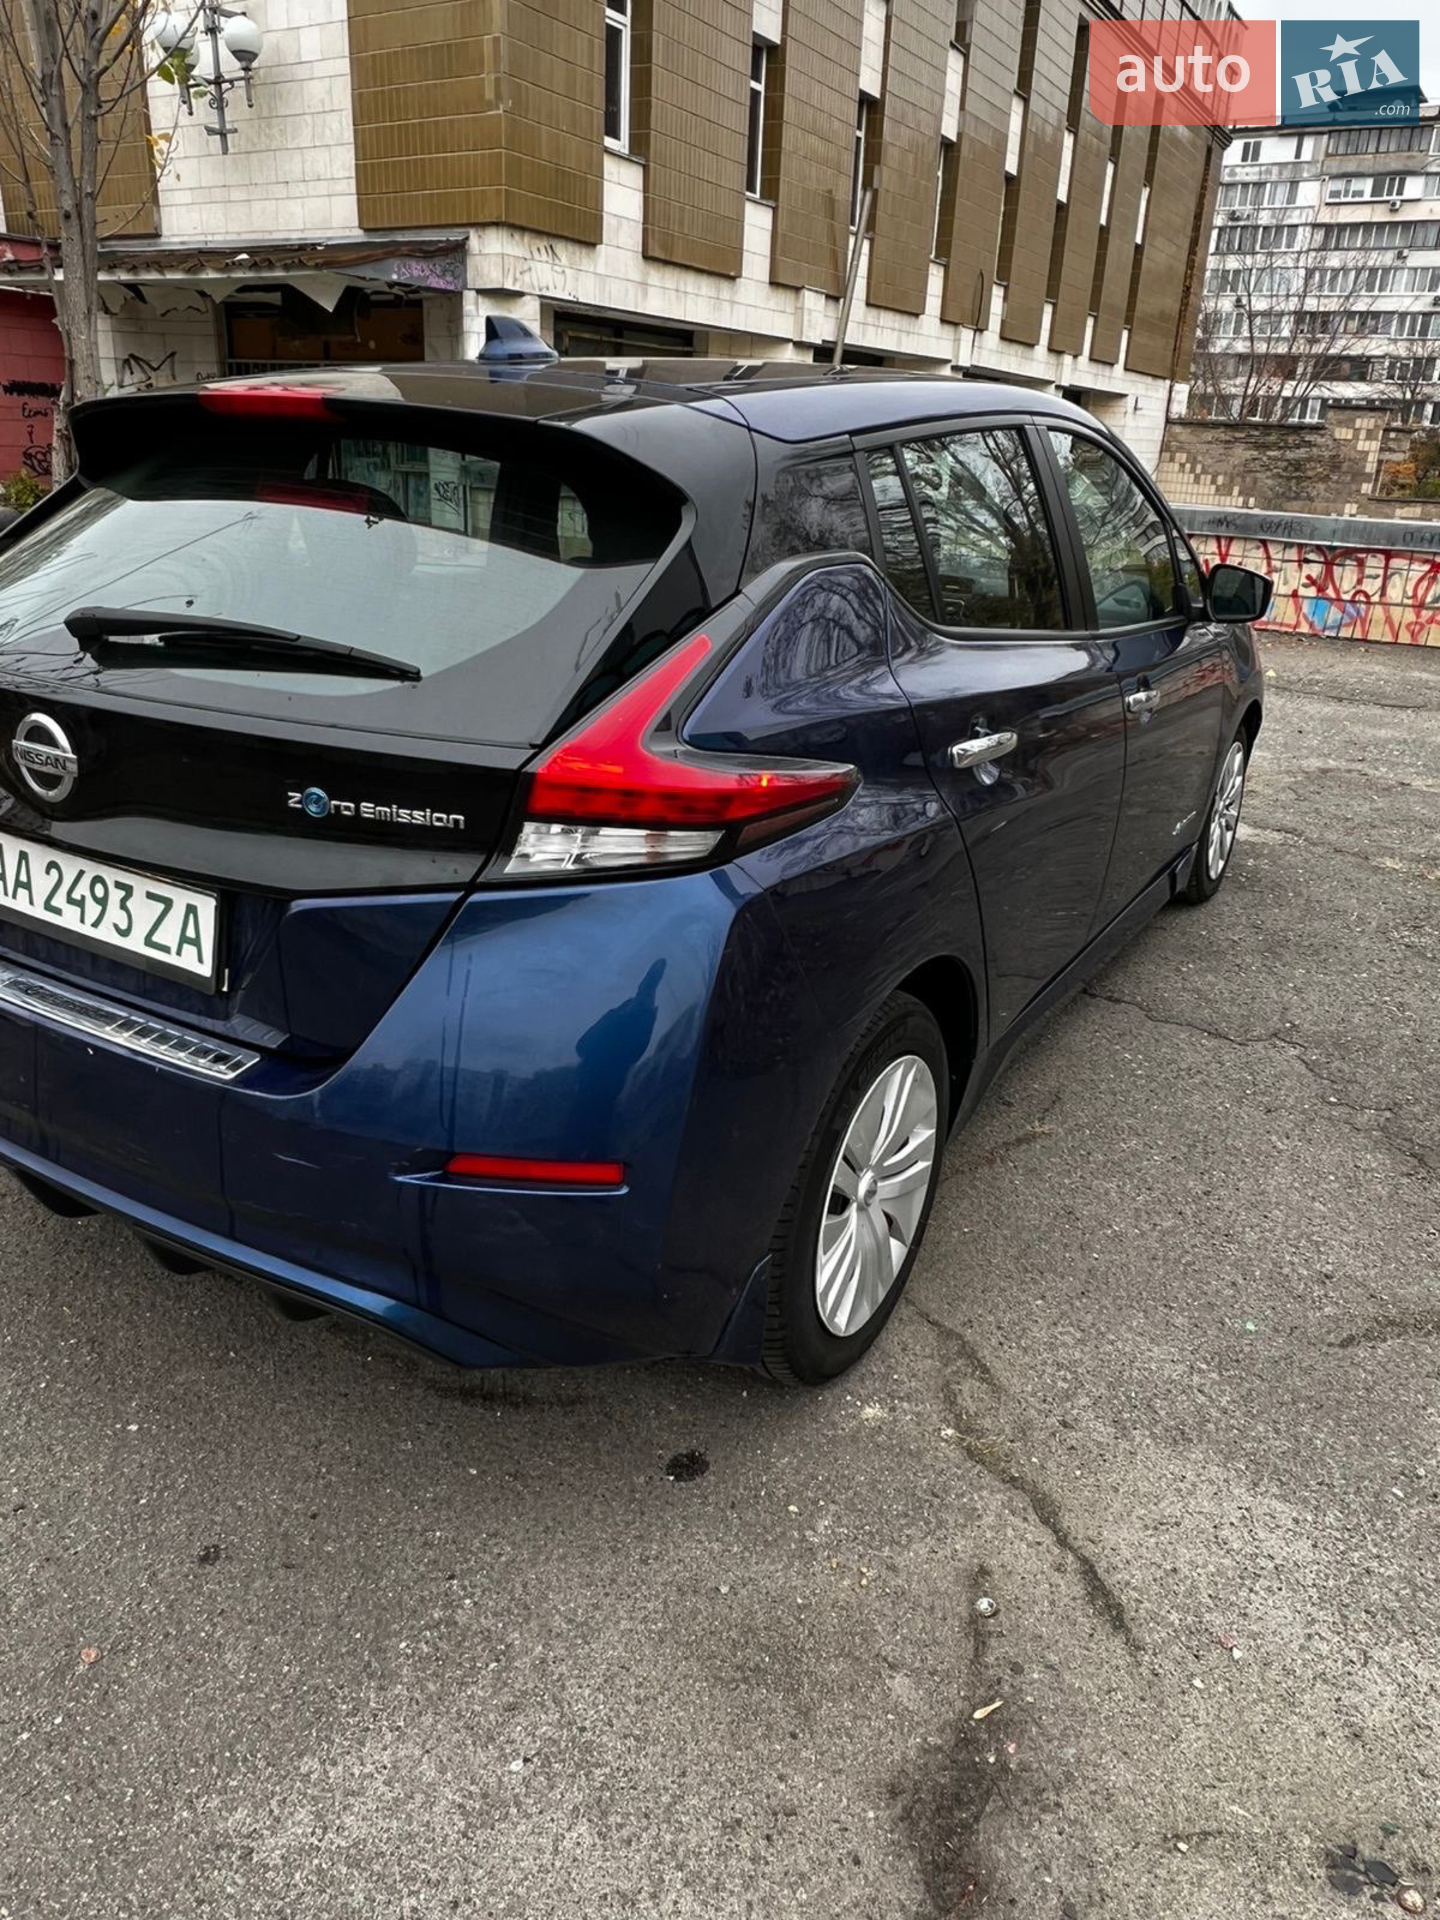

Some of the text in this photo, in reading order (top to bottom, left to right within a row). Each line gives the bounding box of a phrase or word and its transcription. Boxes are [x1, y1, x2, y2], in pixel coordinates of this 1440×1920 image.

[15, 743, 68, 771] NISSAN
[360, 801, 465, 829] Emission
[43, 859, 134, 938] 2493
[143, 890, 204, 964] ZA
